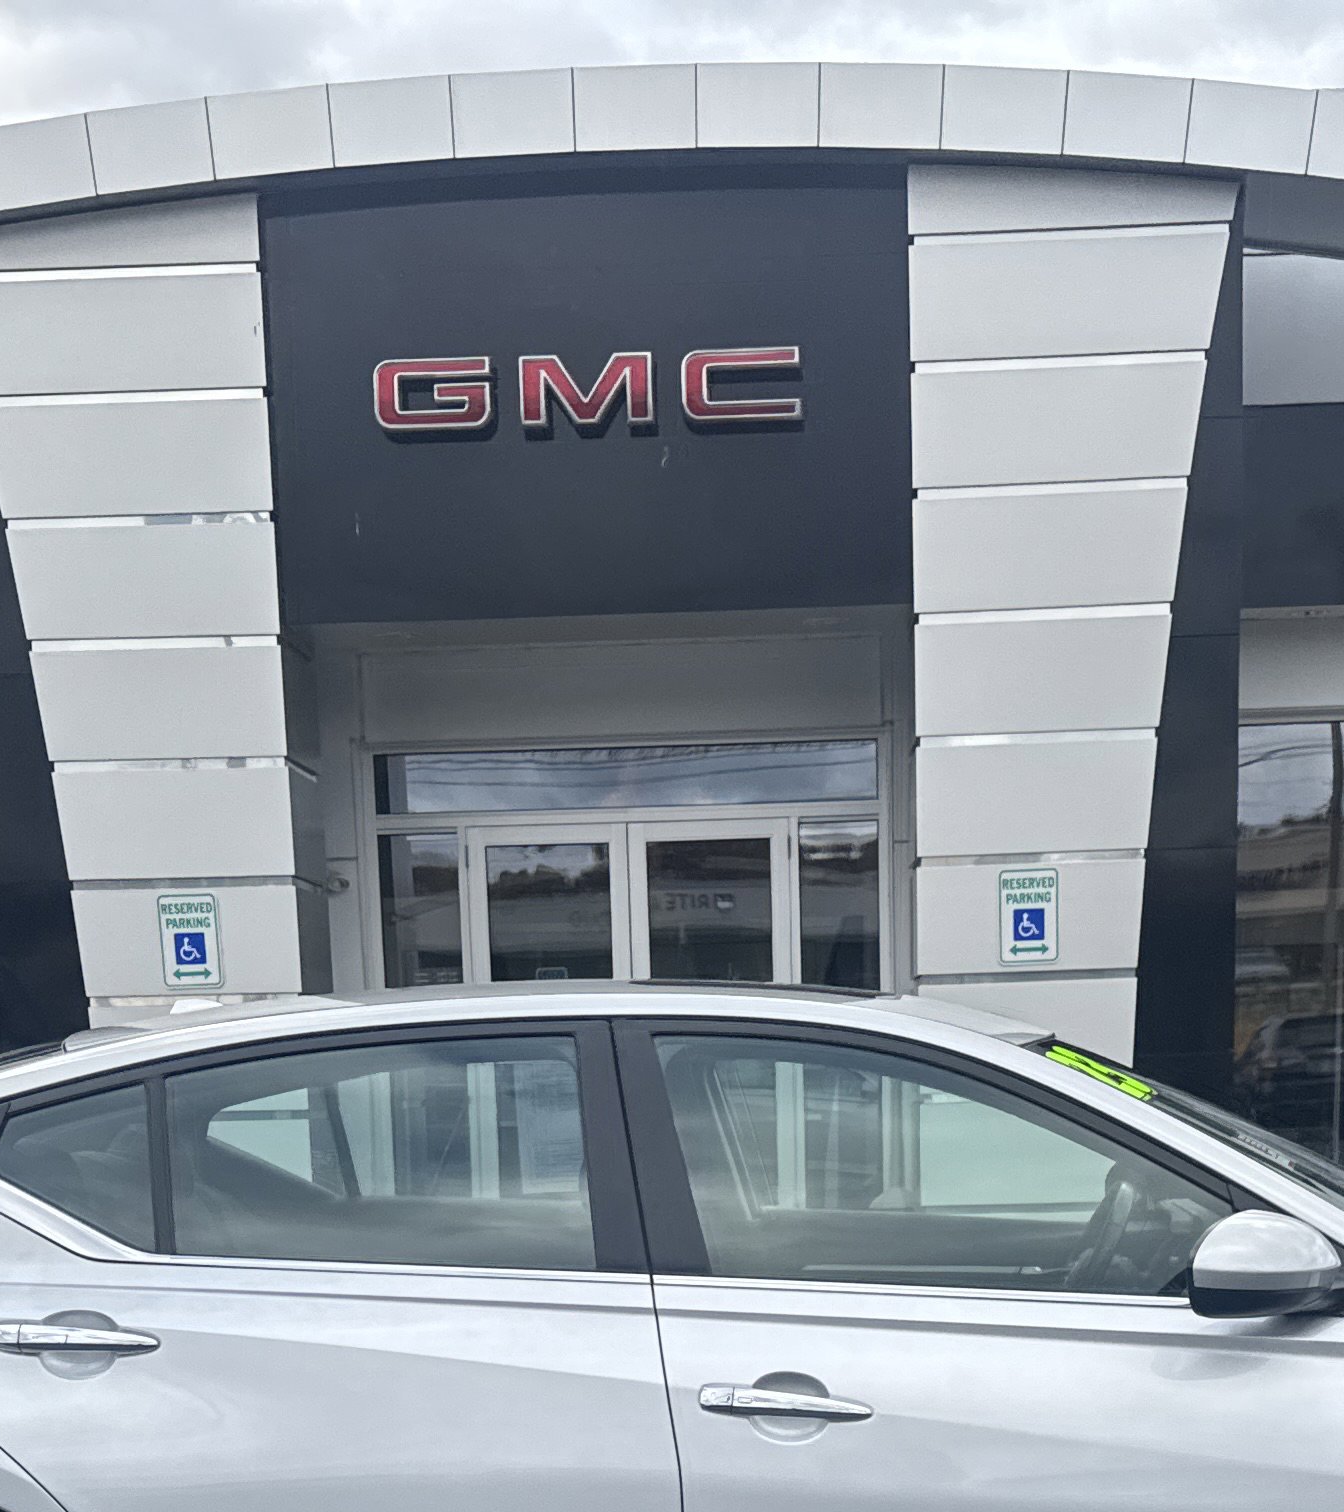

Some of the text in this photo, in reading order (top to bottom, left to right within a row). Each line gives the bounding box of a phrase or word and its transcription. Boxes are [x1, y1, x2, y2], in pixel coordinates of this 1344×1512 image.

[373, 346, 802, 430] GMC
[1001, 876, 1055, 890] RESERVED
[1005, 891, 1052, 904] PARKING
[160, 902, 213, 915] RESERVED
[165, 916, 211, 929] PARKING
